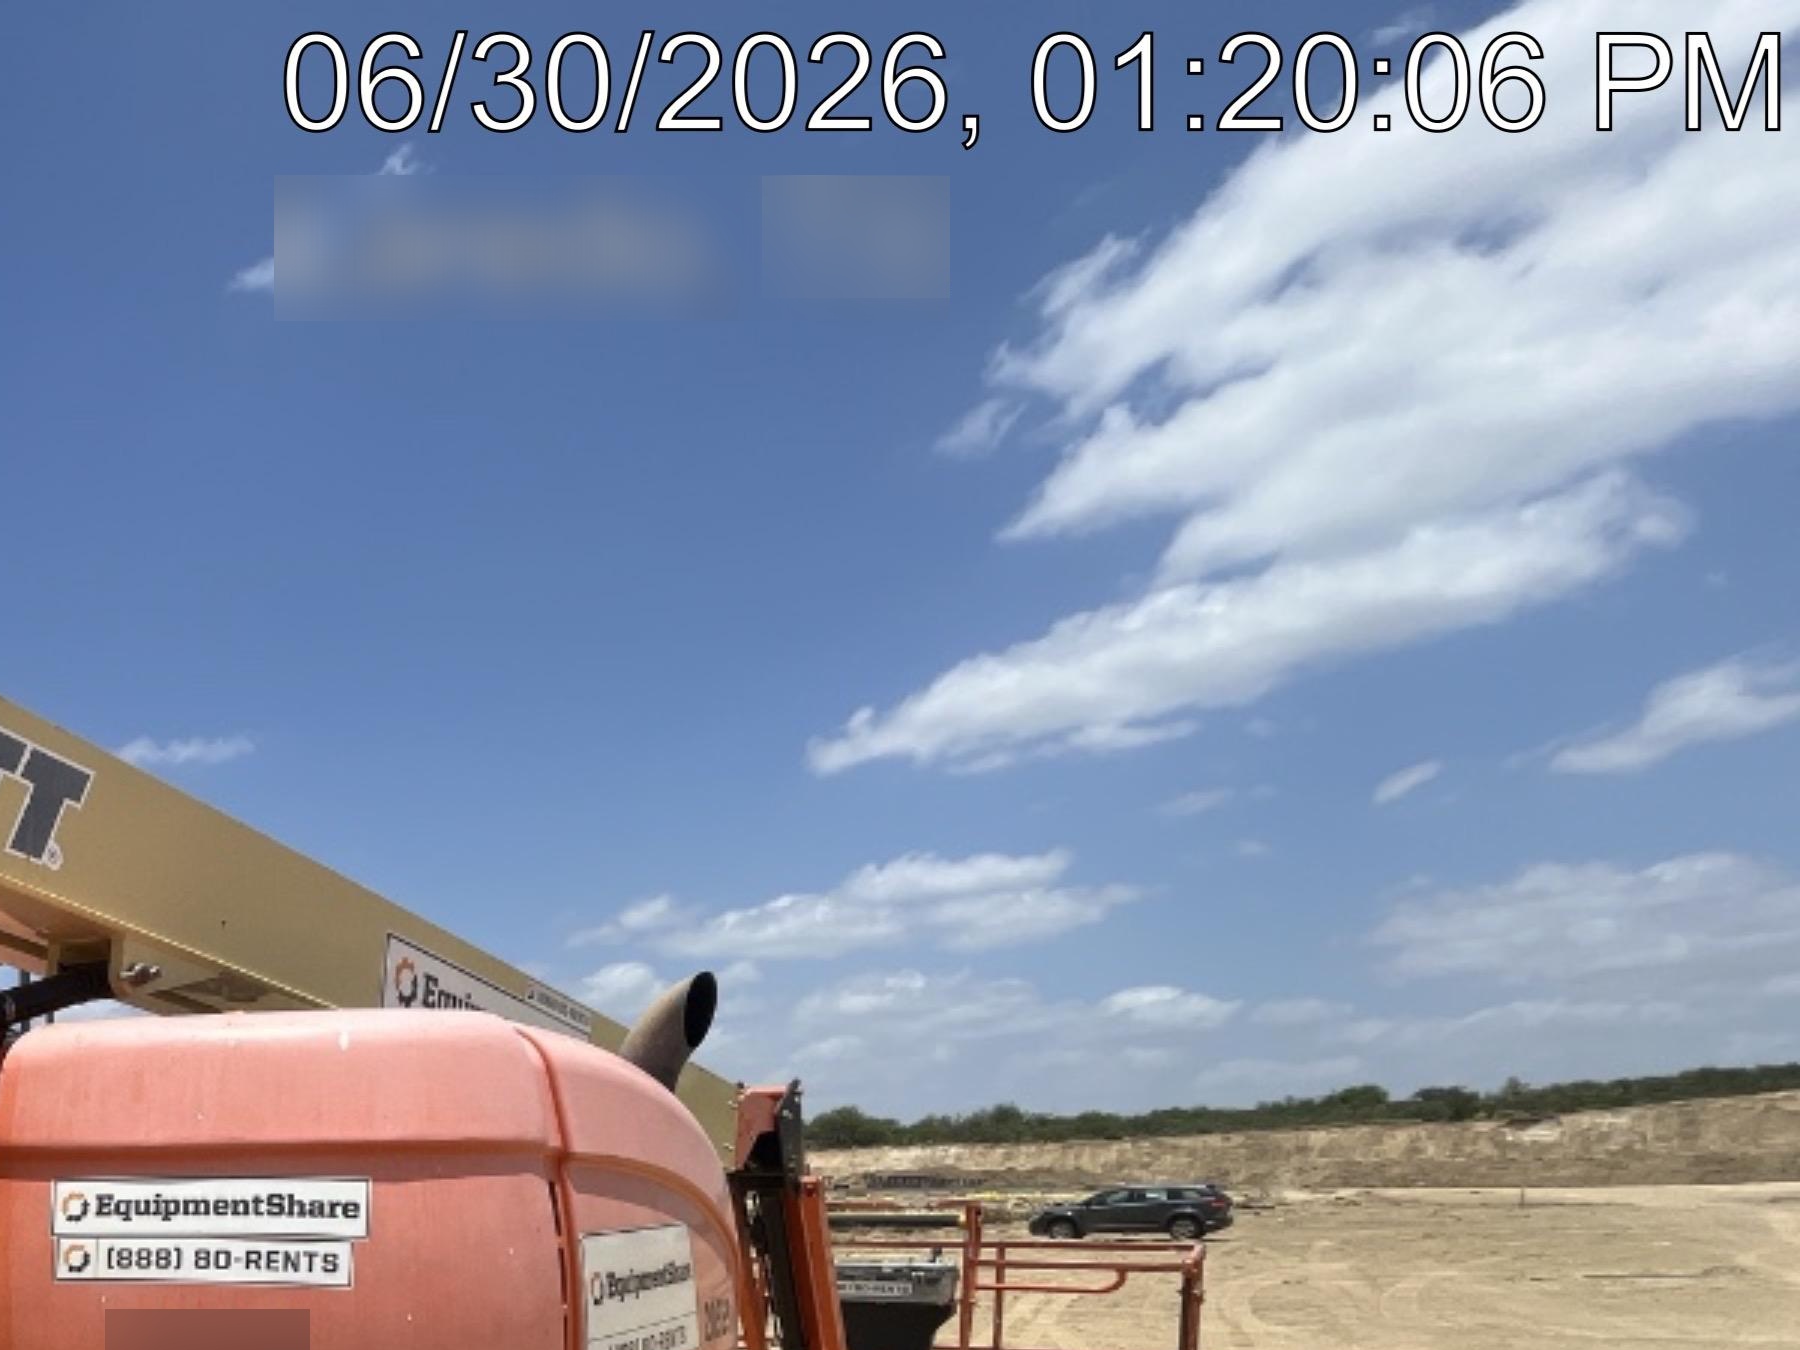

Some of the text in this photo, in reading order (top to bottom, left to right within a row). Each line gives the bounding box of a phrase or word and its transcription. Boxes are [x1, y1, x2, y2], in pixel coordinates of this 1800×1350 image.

[94, 1193, 361, 1222] EquipmentShare
[106, 1247, 340, 1273] (888) 80-RENTS
